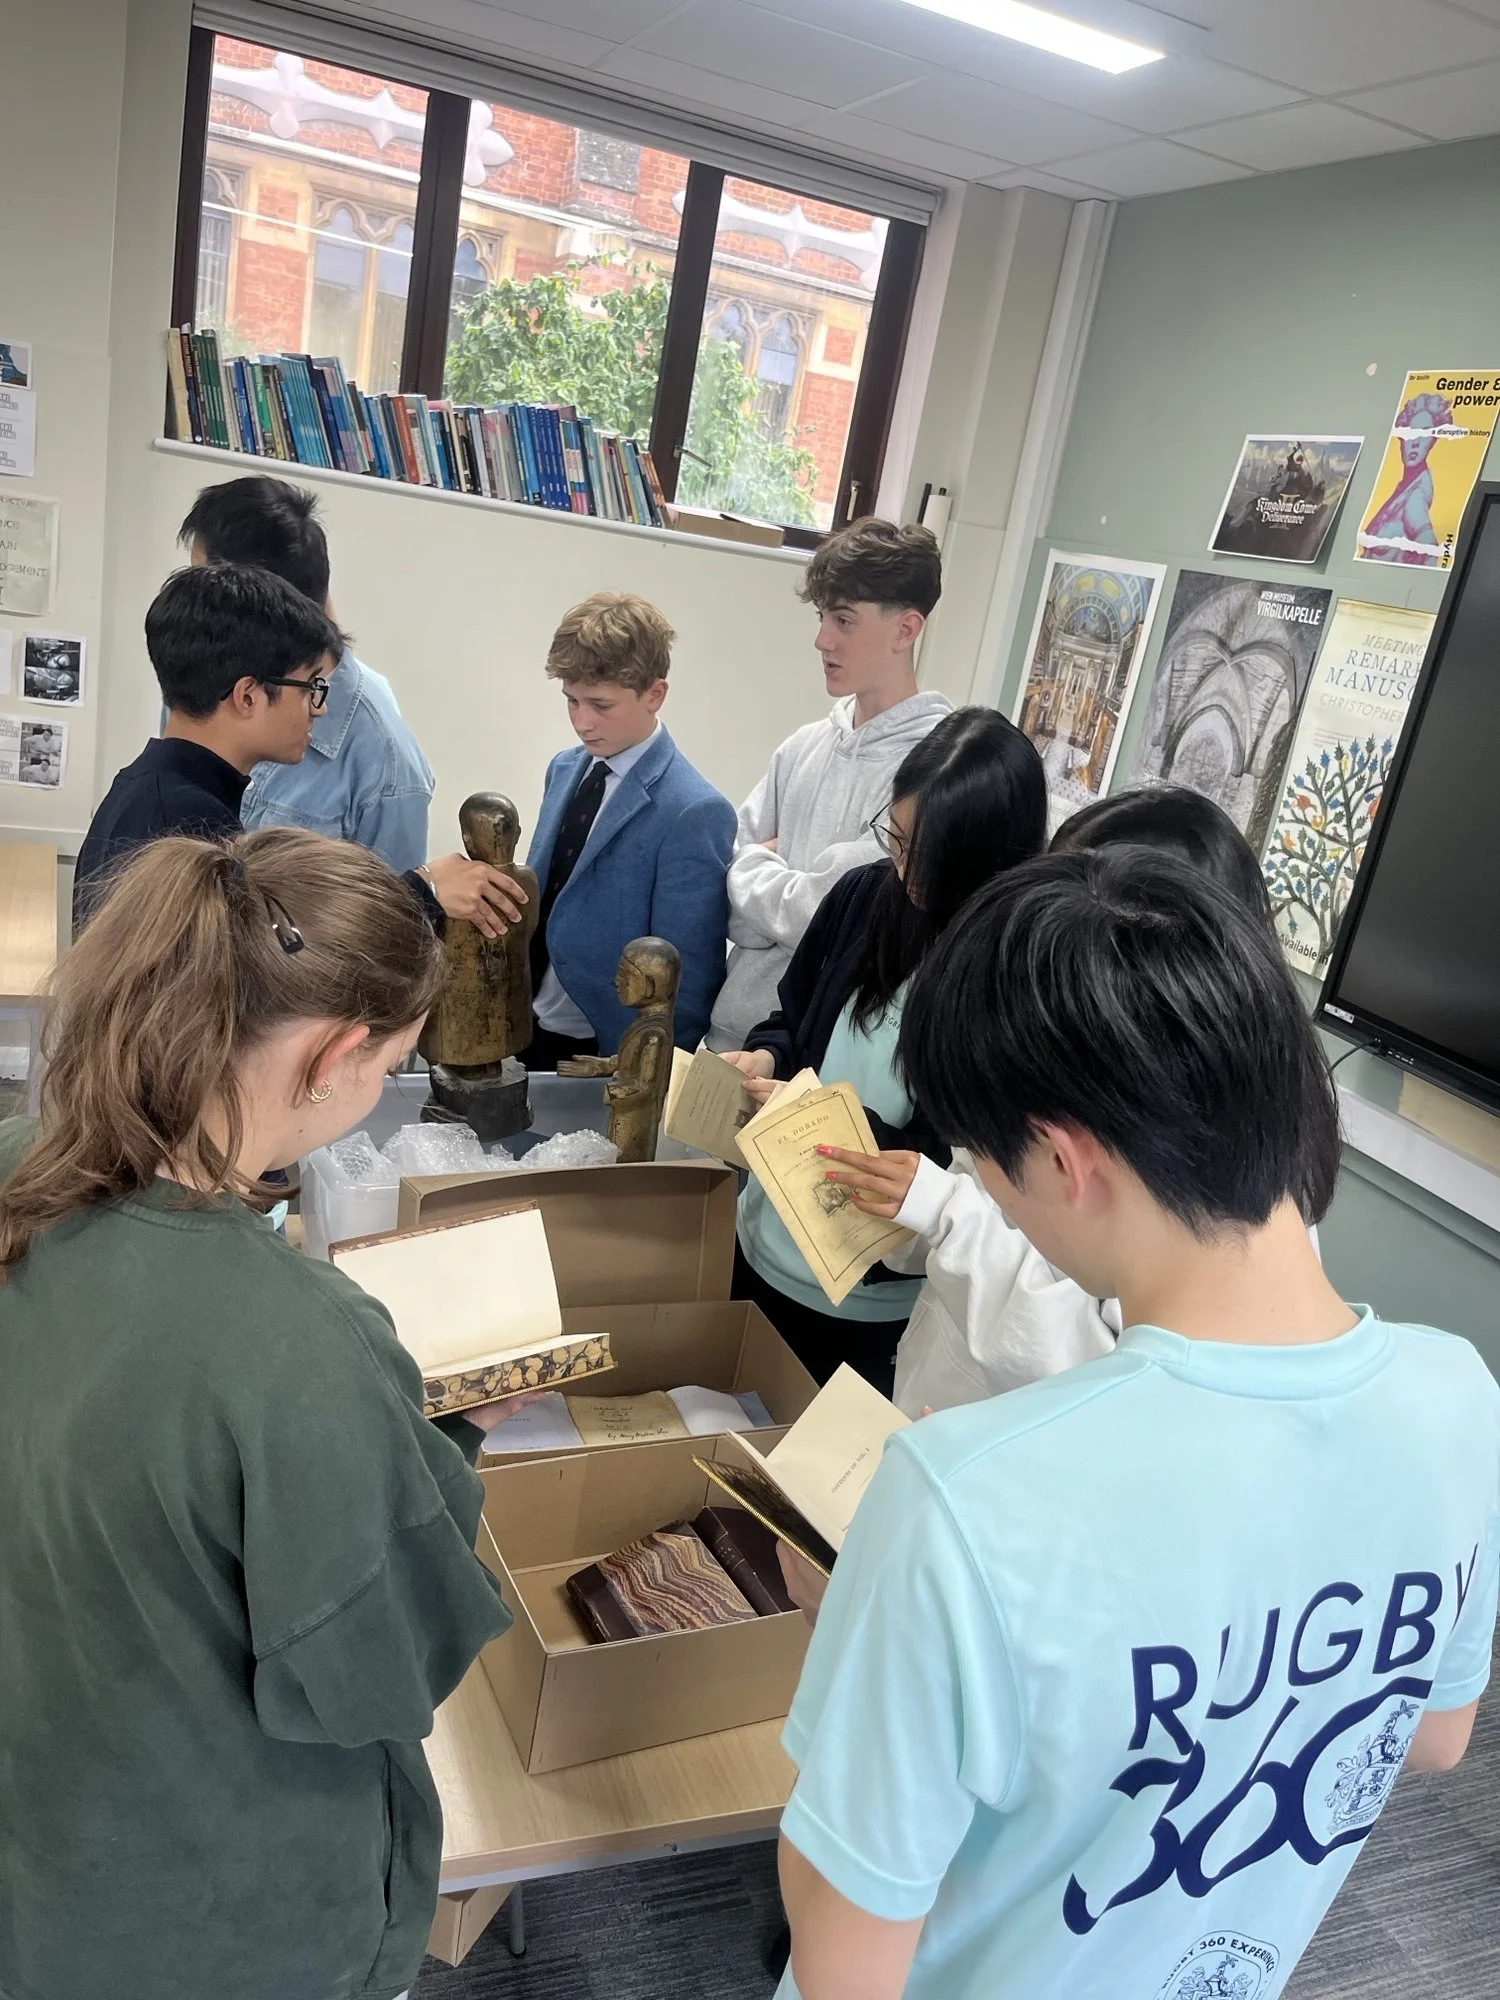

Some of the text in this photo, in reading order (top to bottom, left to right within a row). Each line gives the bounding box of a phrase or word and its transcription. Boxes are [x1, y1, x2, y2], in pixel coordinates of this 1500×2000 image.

[1436, 377, 1489, 391] Gender
[1453, 395, 1500, 409] power
[1469, 429, 1491, 437] history
[1256, 497, 1321, 514] Kingdom Come
[1261, 511, 1305, 525] Deliverance
[1272, 592, 1296, 604] MUSEUM
[1257, 600, 1322, 625] VIRGILKAPELLE
[1280, 934, 1318, 961] Available
[792, 1114, 830, 1137] DORADO
[831, 1470, 852, 1493] CONTENTS
[1062, 1676, 1434, 1935] 360
[1199, 1936, 1226, 1950] 360
